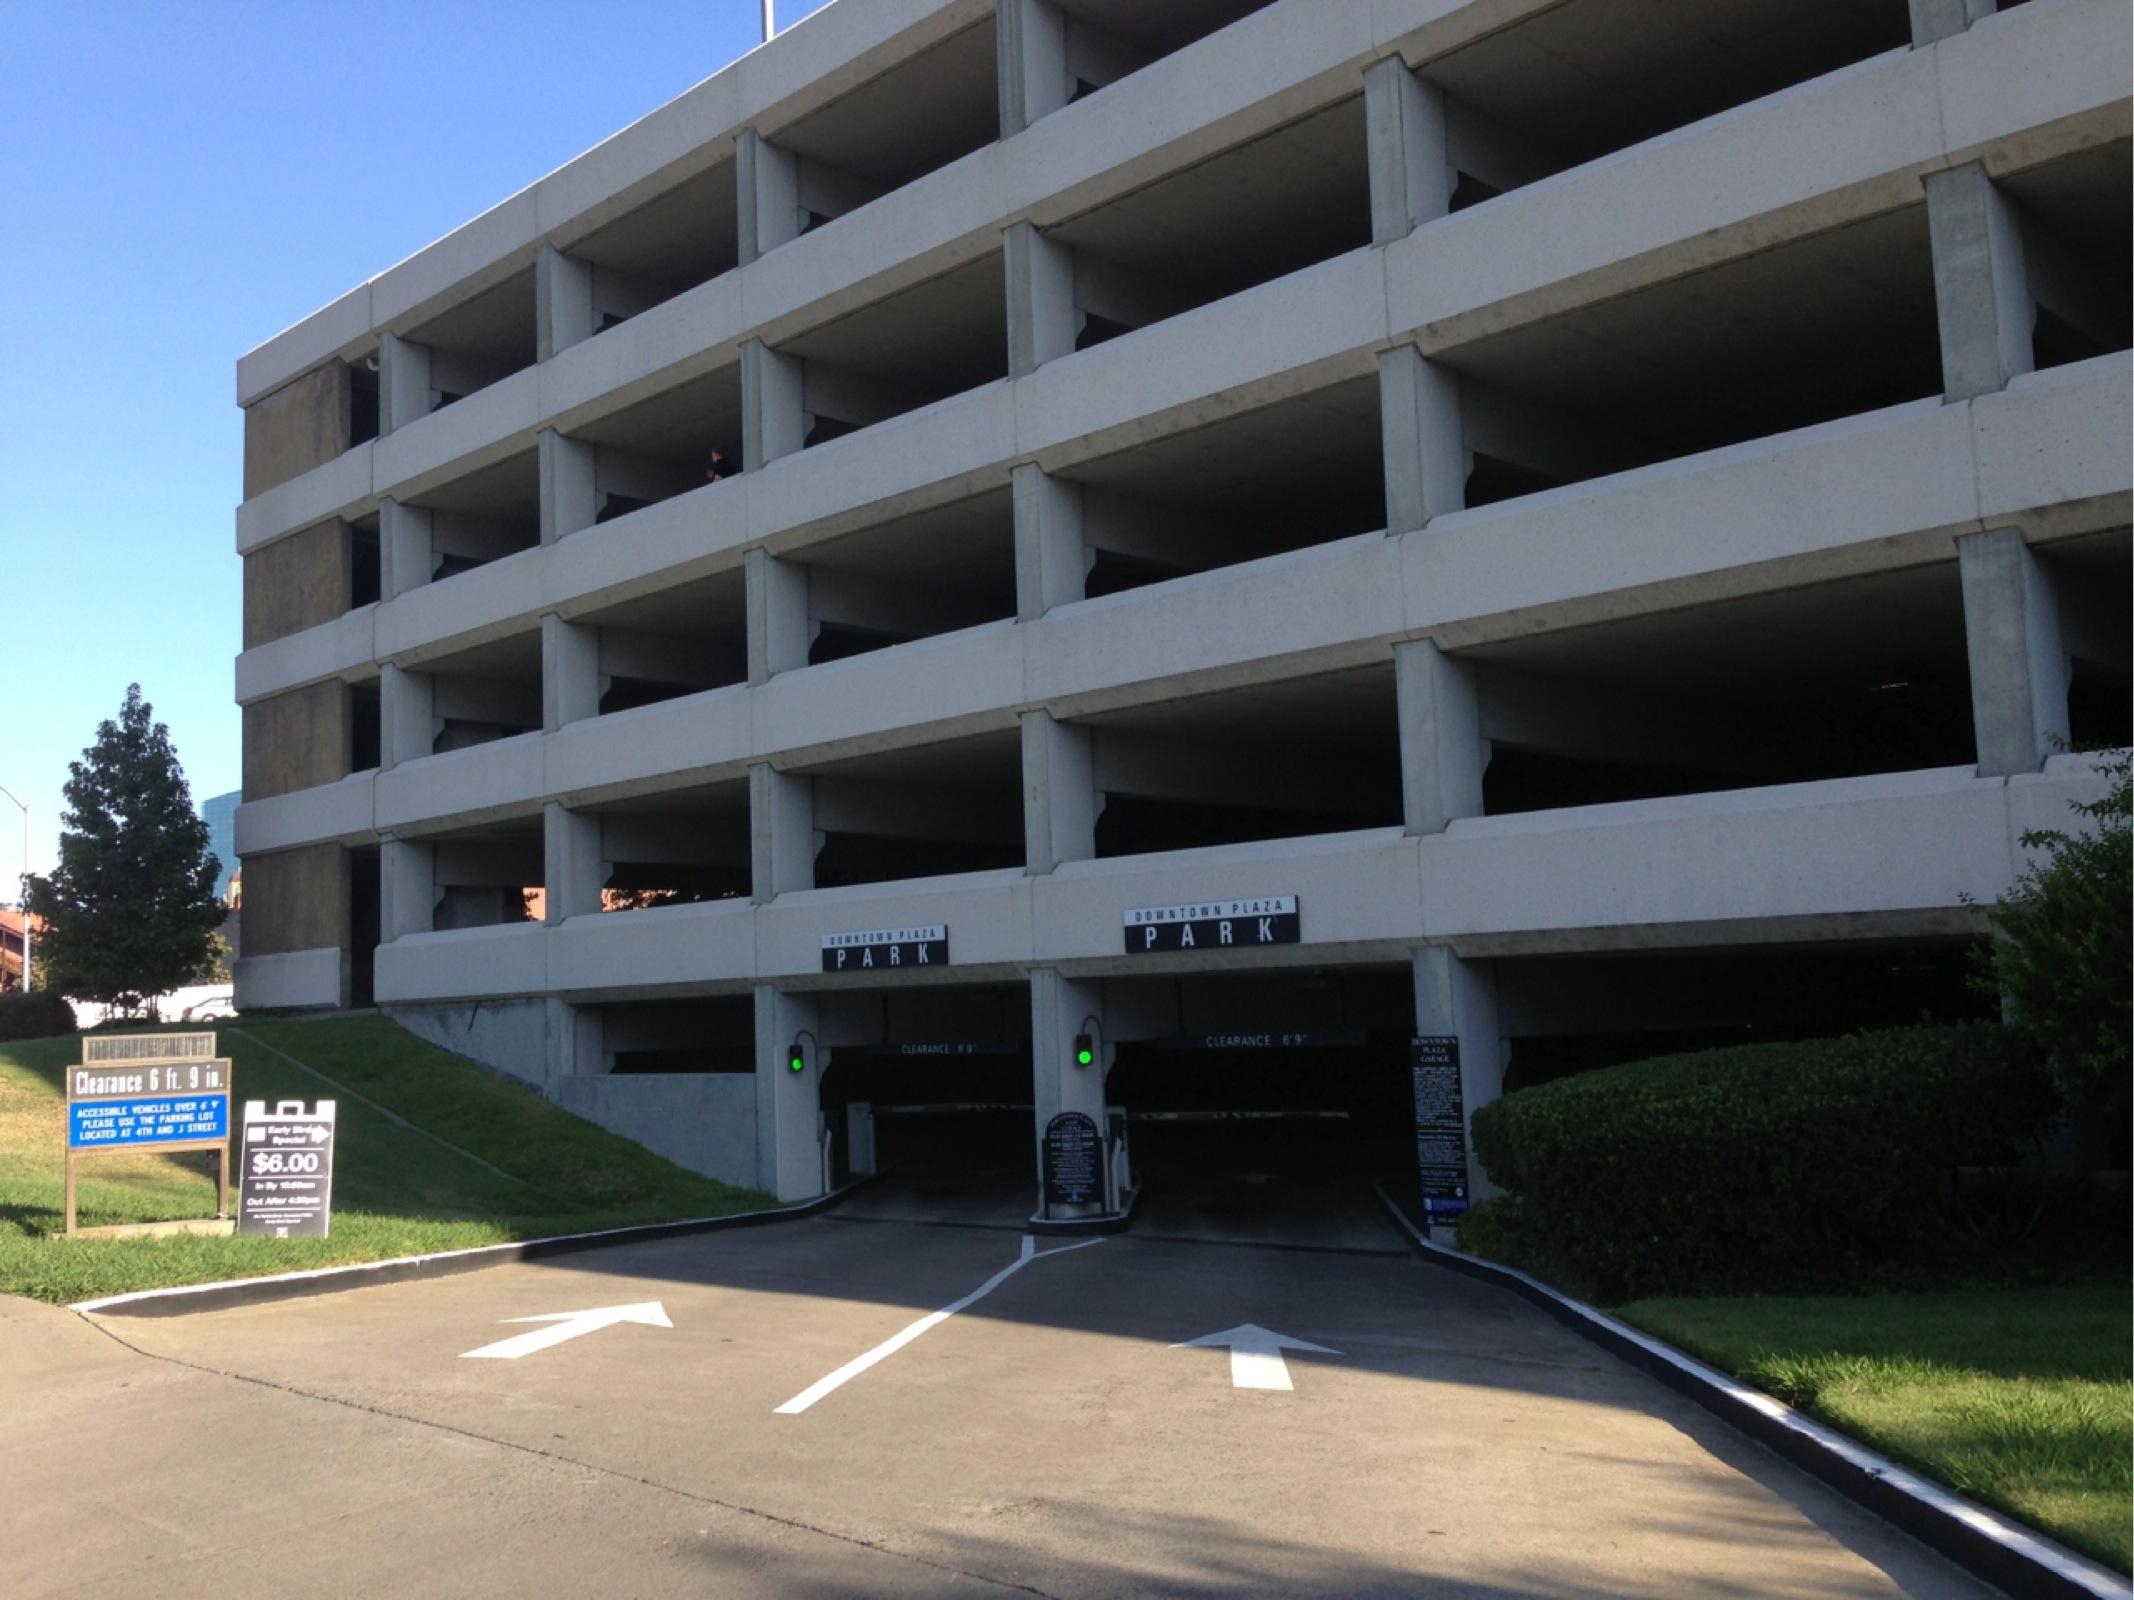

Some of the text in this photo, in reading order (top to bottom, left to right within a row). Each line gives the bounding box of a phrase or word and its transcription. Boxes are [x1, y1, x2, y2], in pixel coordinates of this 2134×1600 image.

[1134, 899, 1283, 922] DOWNTOWN PLAZA
[829, 927, 937, 945] DOWNTOWN PLAZA
[1145, 916, 1274, 949] PARK
[837, 942, 929, 969] PARK
[901, 1043, 950, 1055] CLEARANCE
[1206, 1034, 1271, 1047] CLEARANCE
[76, 1064, 224, 1094] Clearance 6 ft. 9 in.
[77, 1107, 128, 1118] ACCESSIBLE
[132, 1103, 170, 1114] VEHICLES
[175, 1102, 197, 1112] OVER
[82, 1111, 214, 1129] PLEASE USE THE PARKING LOT
[79, 1122, 217, 1141] LOCATED AT 4TH AND J STREET
[268, 1126, 291, 1136] Early
[272, 1136, 306, 1145] Special
[252, 1152, 319, 1174] $6.00
[255, 1182, 264, 1190] In
[266, 1182, 277, 1192] By
[247, 1197, 264, 1206] Out
[265, 1197, 287, 1205] After
